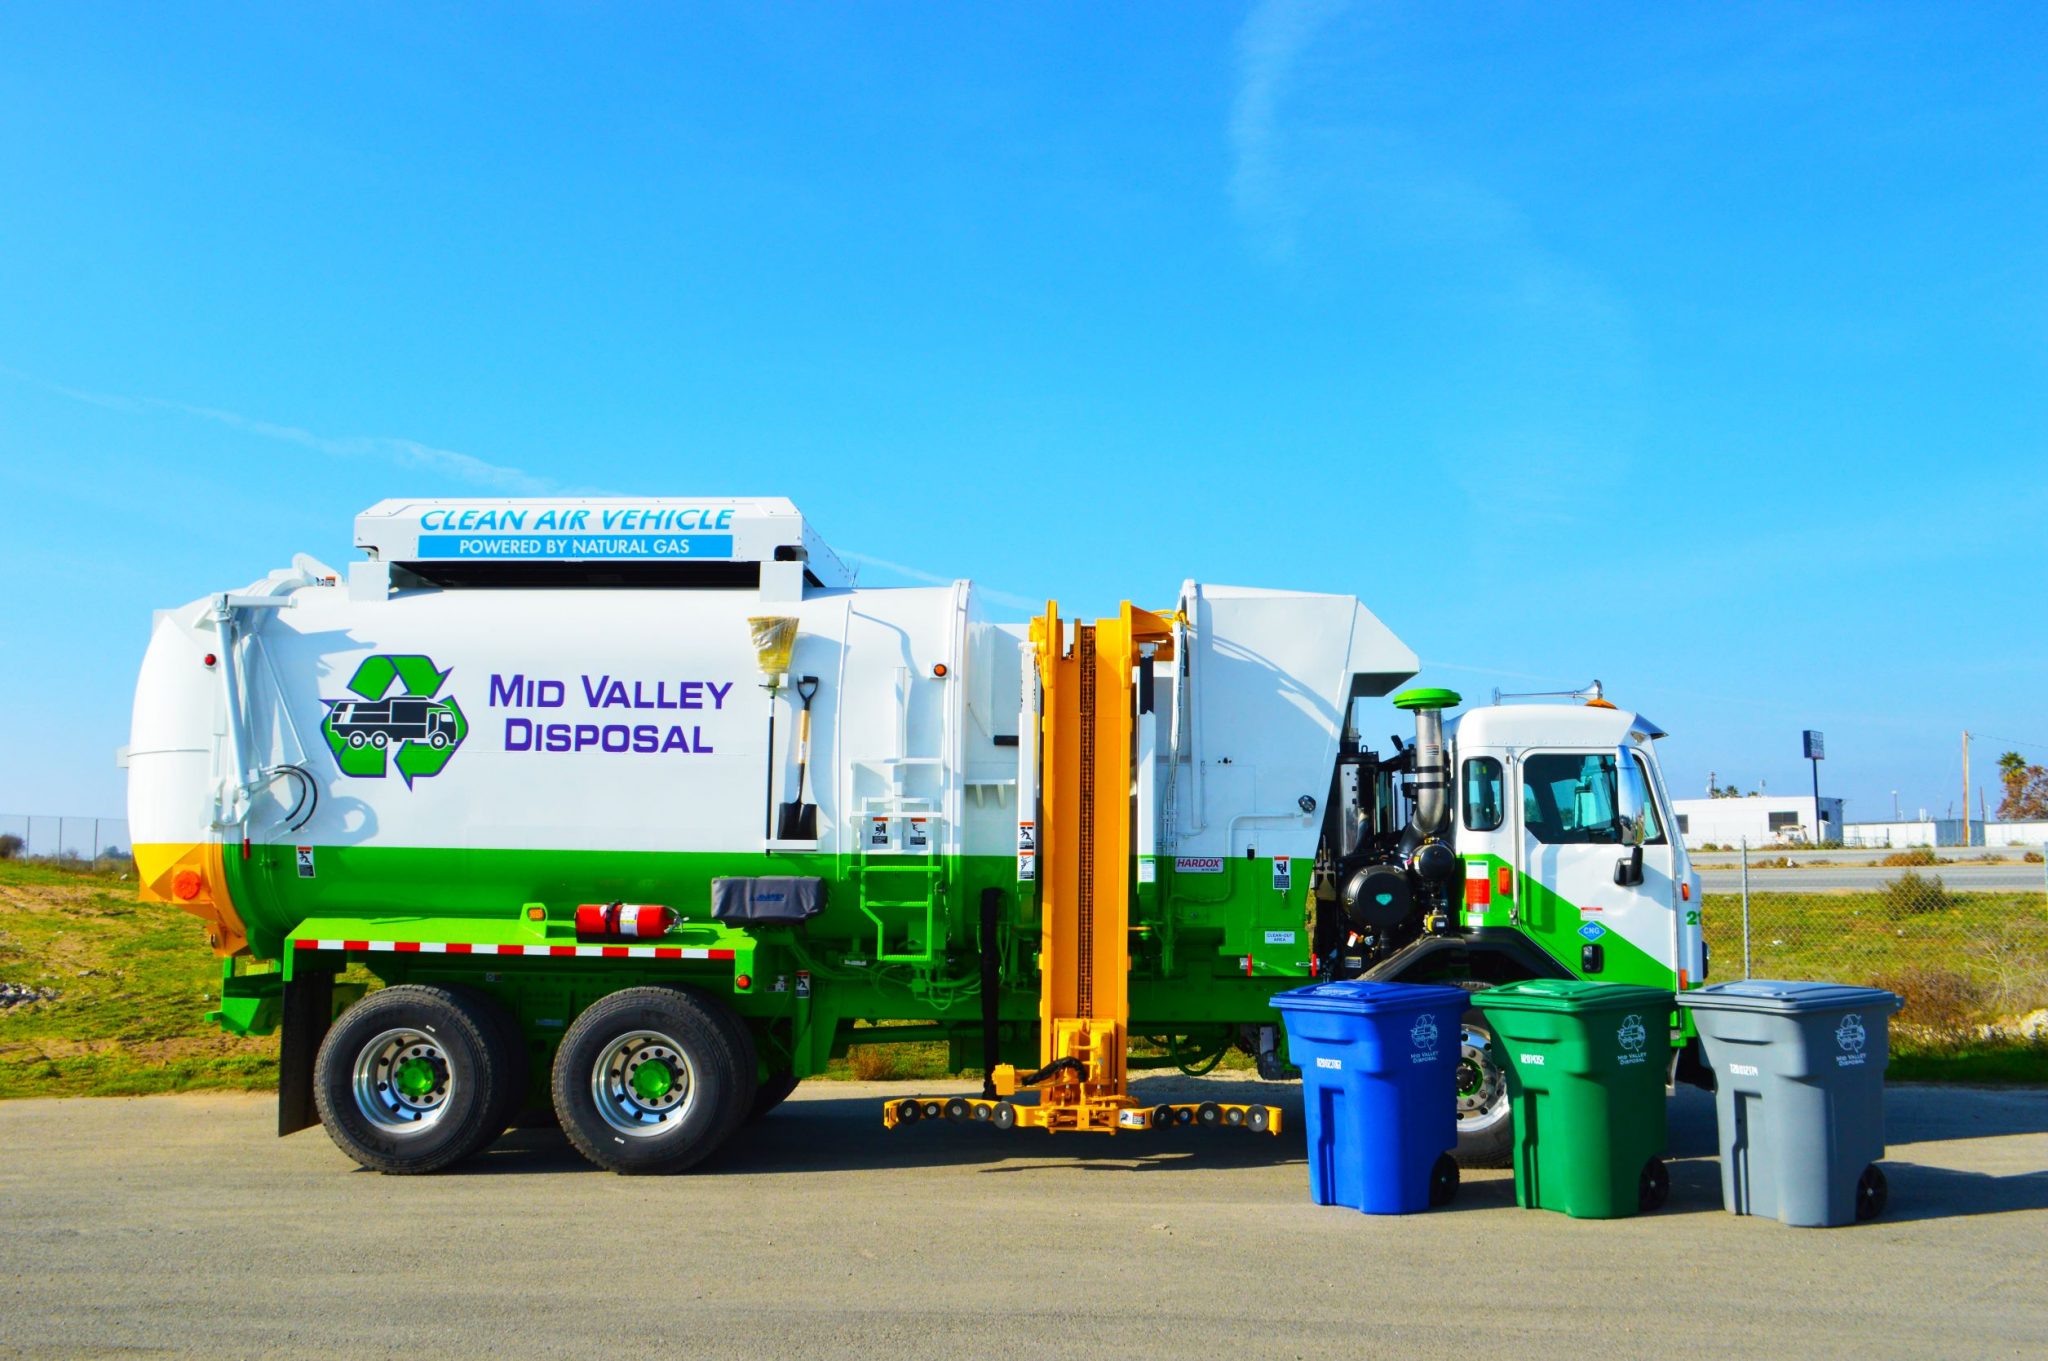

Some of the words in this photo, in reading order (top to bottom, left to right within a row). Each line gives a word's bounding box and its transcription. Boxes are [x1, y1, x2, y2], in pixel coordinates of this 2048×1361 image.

[420, 510, 529, 531] CLEAN
[534, 510, 590, 531] AIR
[601, 509, 736, 531] VEHICLE
[459, 539, 545, 555] POWERED
[548, 539, 567, 554] BY
[572, 539, 650, 554] NATURAL
[653, 538, 690, 554] GAS
[581, 675, 734, 709] VALLEY
[504, 717, 714, 754] DISPOSAL
[1177, 858, 1220, 868] HARDOX
[1583, 927, 1600, 935] CNG
